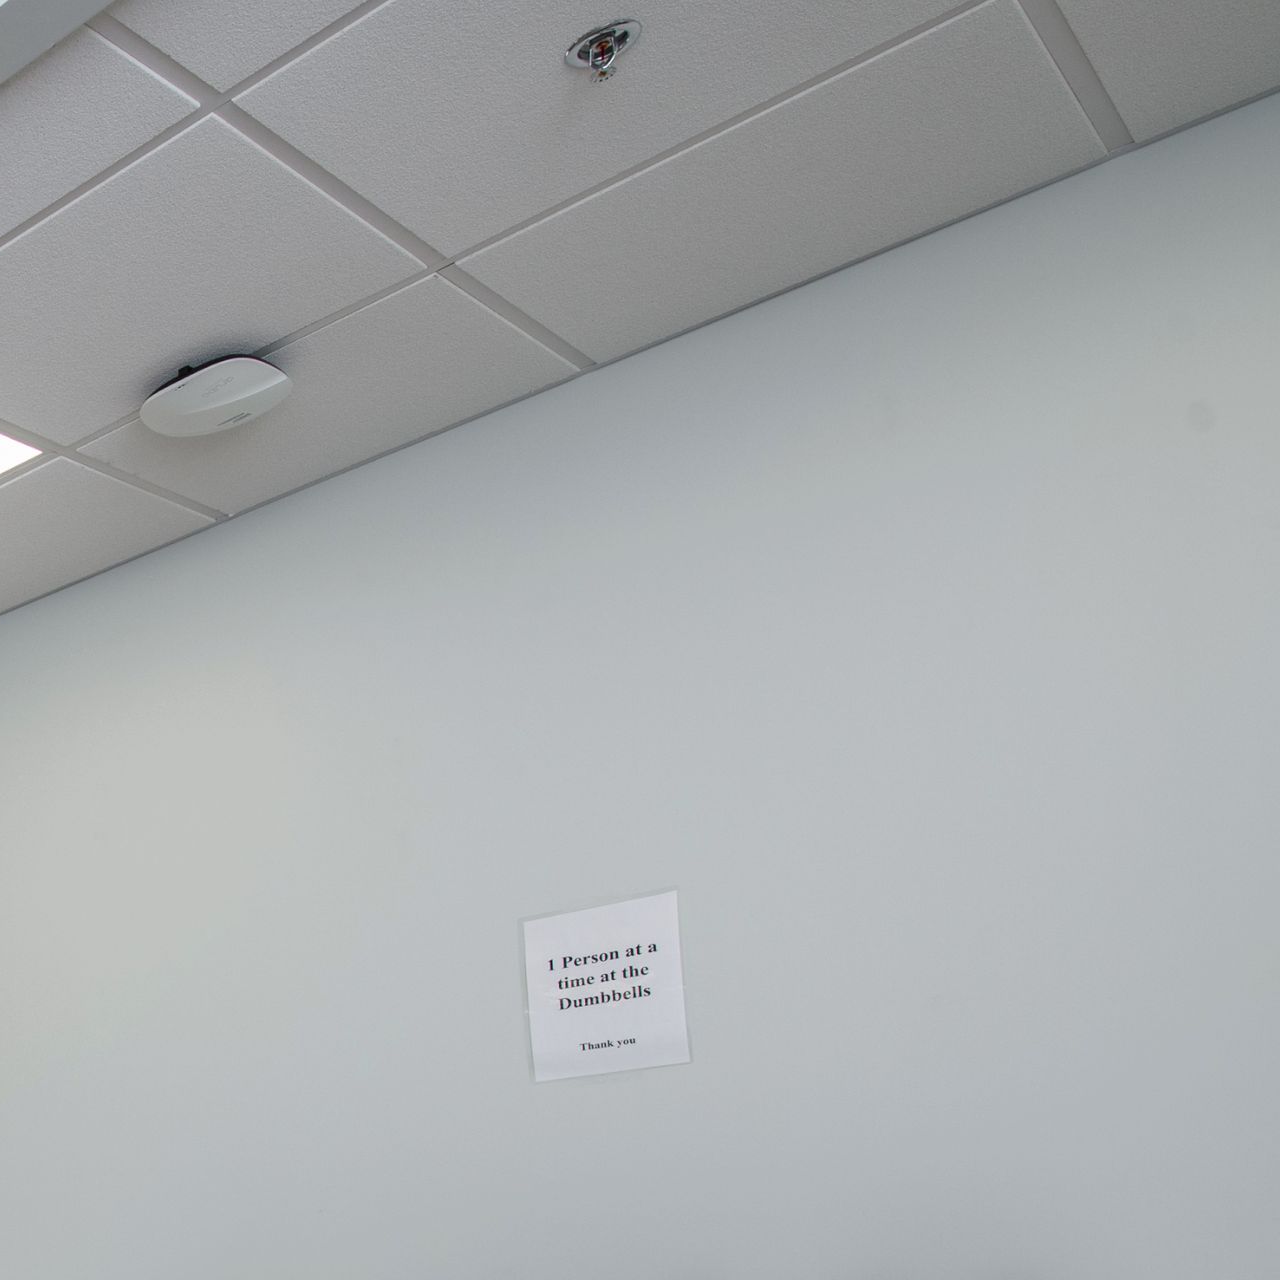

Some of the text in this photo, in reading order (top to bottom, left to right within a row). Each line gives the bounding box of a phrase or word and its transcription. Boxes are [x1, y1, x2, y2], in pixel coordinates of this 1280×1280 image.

[548, 943, 657, 971] 1 Person at a
[558, 966, 649, 990] time at the
[559, 985, 651, 1010] Dumbbells
[580, 1038, 636, 1052] Thank you
